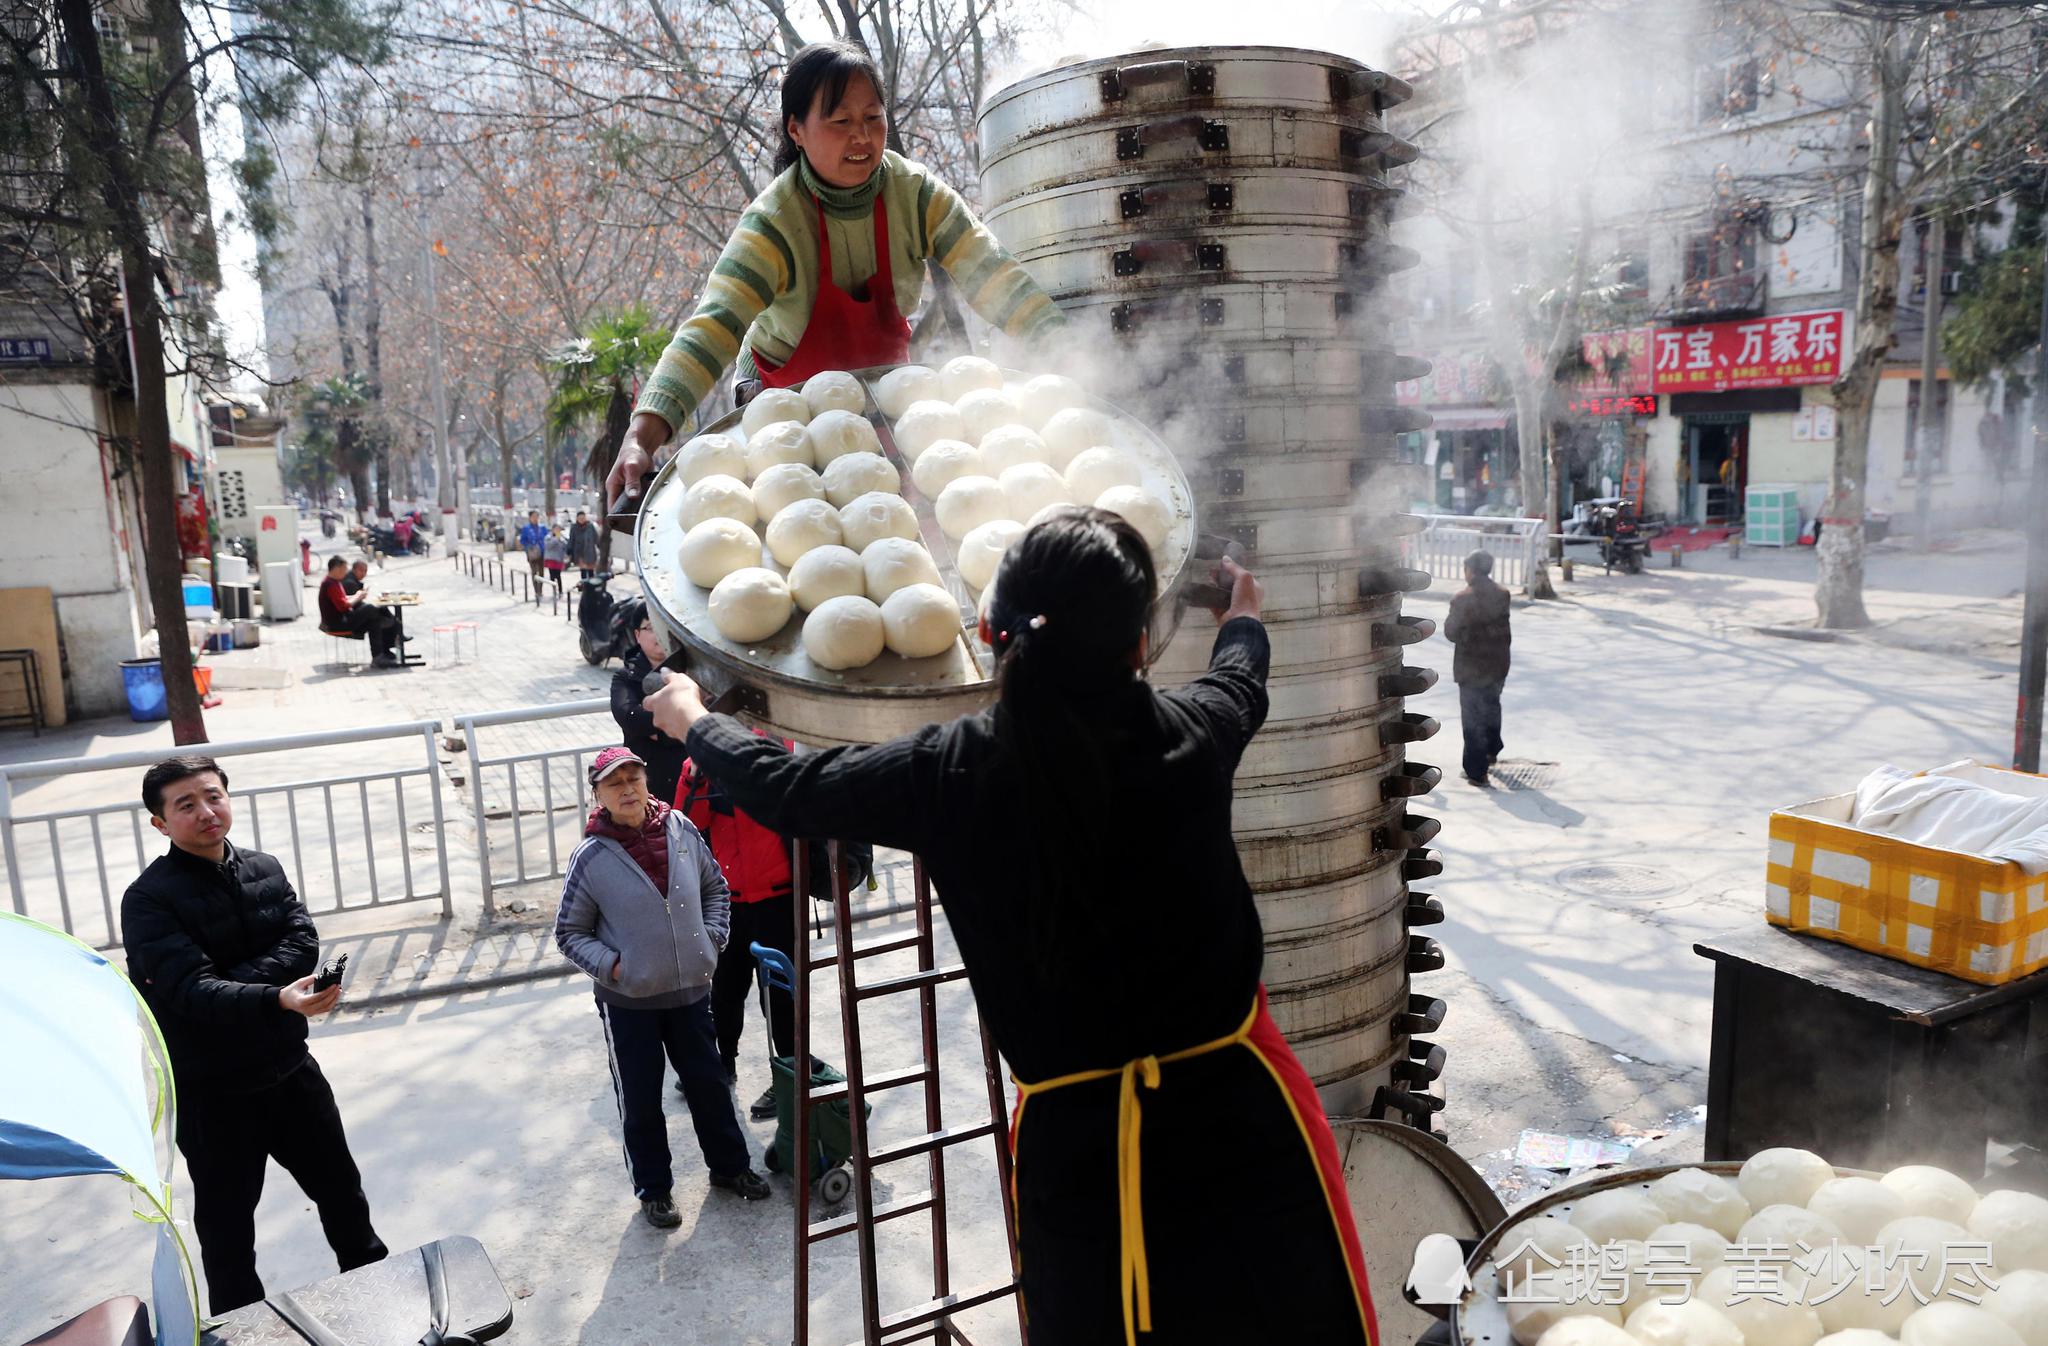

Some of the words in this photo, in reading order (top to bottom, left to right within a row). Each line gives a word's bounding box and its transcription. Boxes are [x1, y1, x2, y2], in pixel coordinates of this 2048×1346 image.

[1656, 315, 1837, 370] 万宝、万家乐
